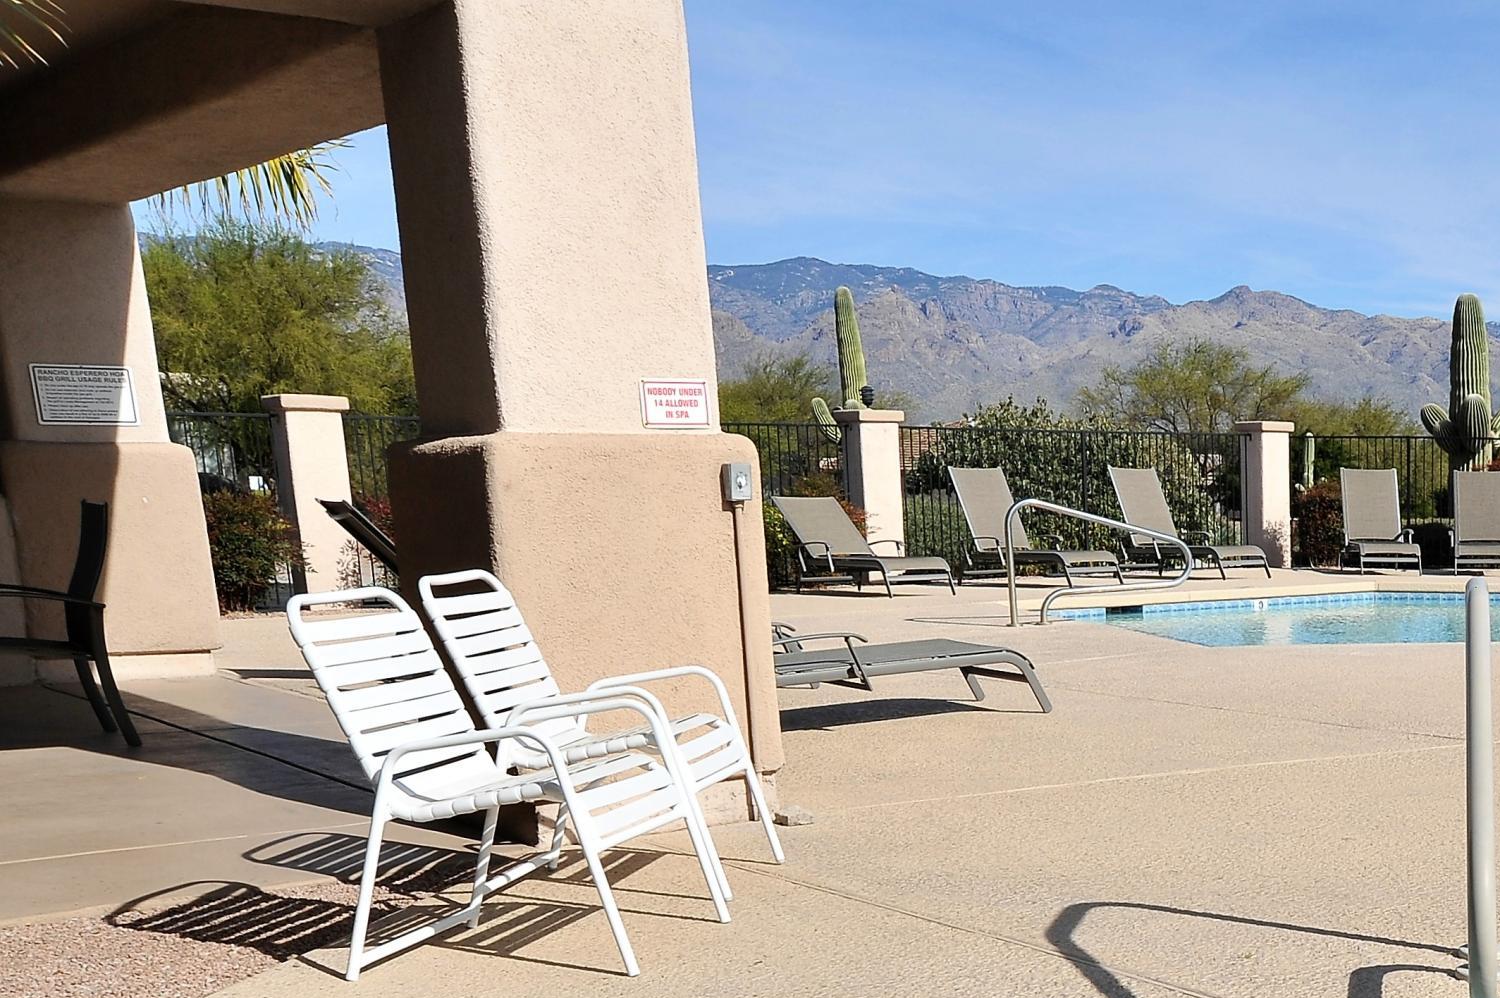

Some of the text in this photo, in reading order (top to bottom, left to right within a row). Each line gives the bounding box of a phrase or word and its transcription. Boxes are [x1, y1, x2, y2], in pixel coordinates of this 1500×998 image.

[647, 387, 703, 396] NOBODY UNDER
[654, 399, 699, 407] 14 ALLOWED
[665, 410, 690, 419] IN SPA
